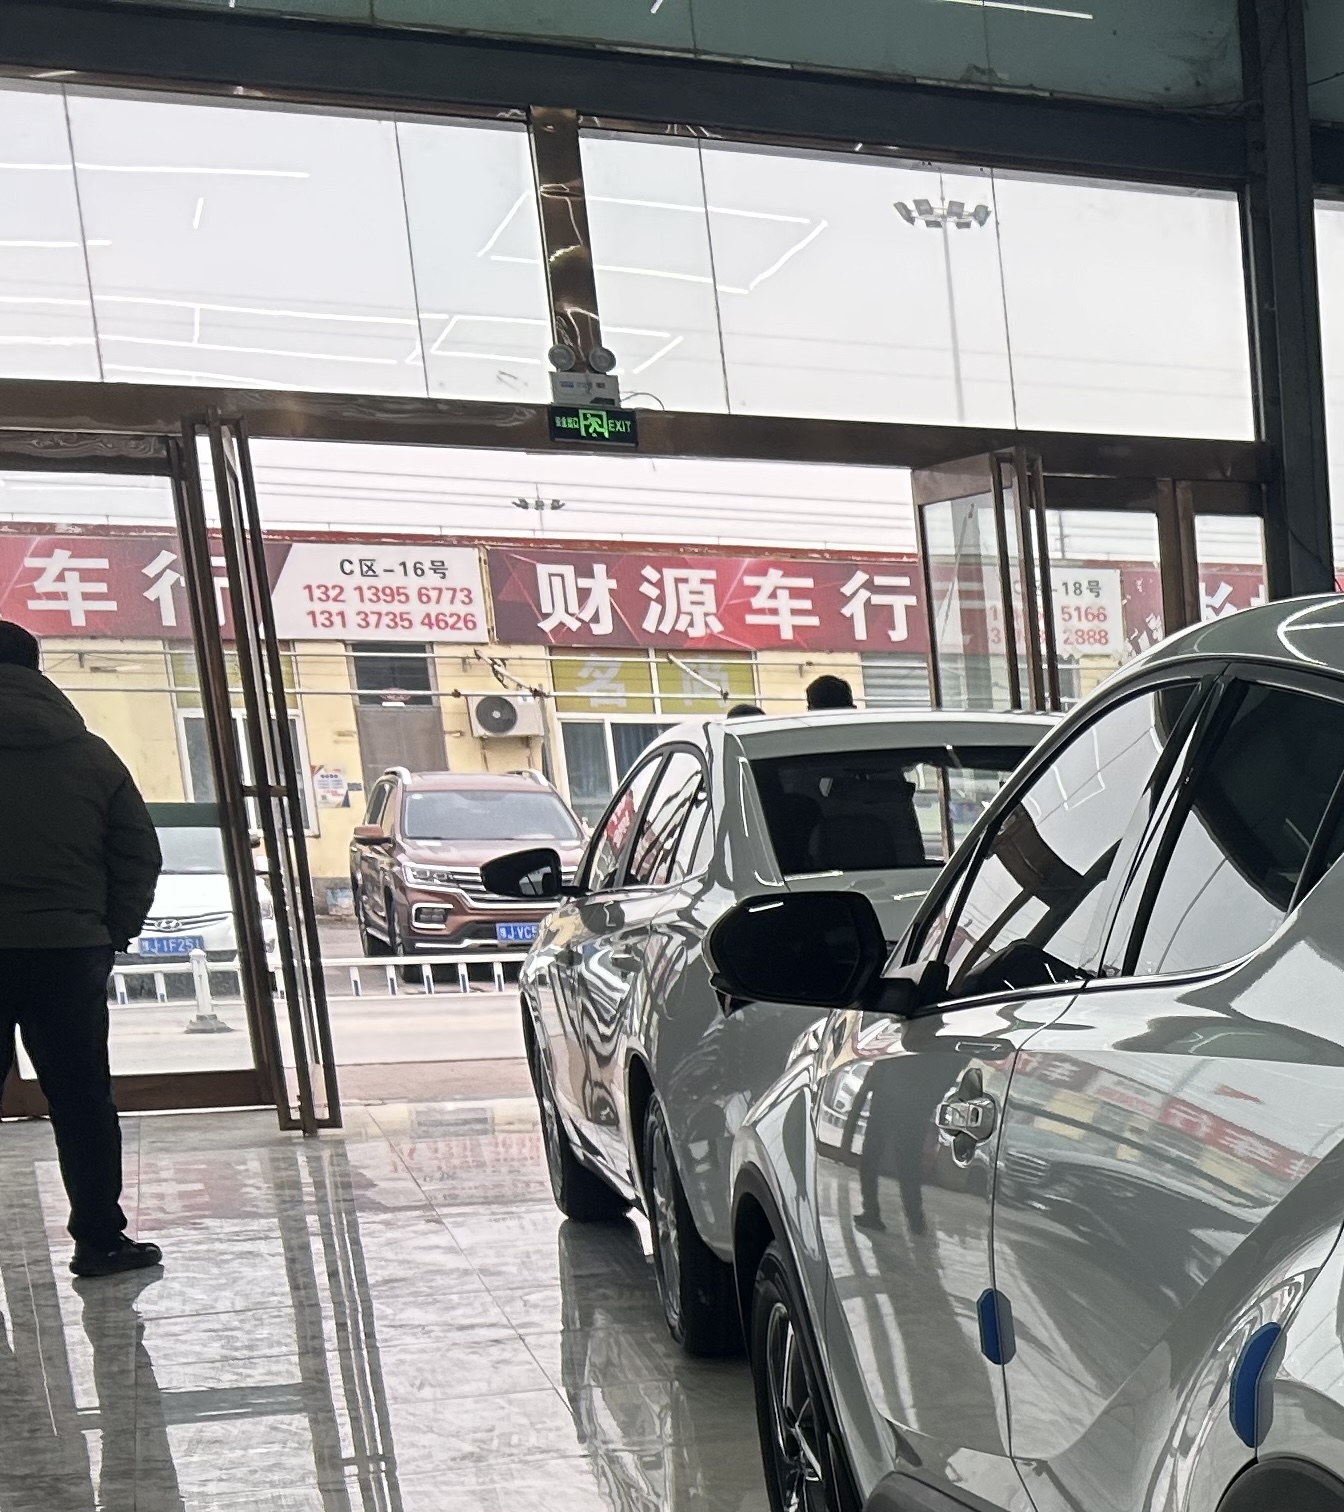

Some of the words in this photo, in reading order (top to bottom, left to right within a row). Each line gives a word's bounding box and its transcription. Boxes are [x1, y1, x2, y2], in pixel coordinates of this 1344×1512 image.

[608, 420, 632, 433] EXIT
[340, 558, 449, 580] C区-16号
[303, 584, 346, 603] 132
[353, 586, 410, 604] 1395
[417, 587, 474, 605] 6773
[535, 563, 918, 642] 财源车行
[306, 610, 347, 628] 131
[356, 611, 414, 630] 3735
[421, 613, 478, 631] 4626
[1061, 606, 1108, 623] 5166
